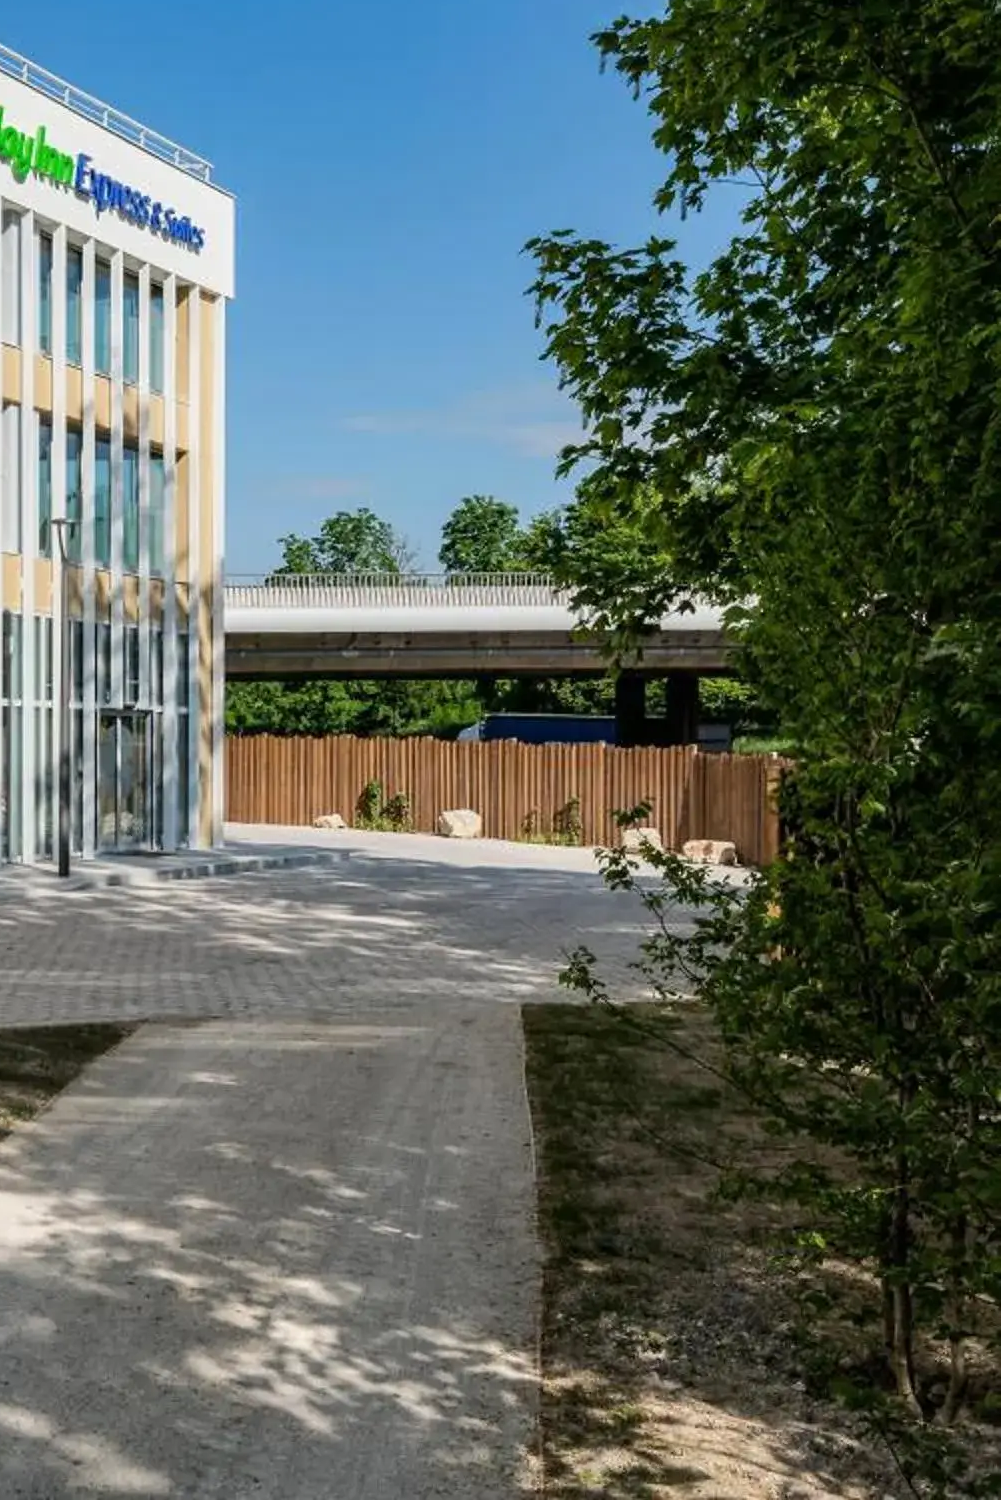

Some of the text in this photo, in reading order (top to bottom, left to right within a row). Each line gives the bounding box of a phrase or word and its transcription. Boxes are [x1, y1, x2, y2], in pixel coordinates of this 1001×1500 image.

[35, 125, 74, 185] Inn
[74, 153, 152, 225] Express
[163, 208, 206, 249] Suites
